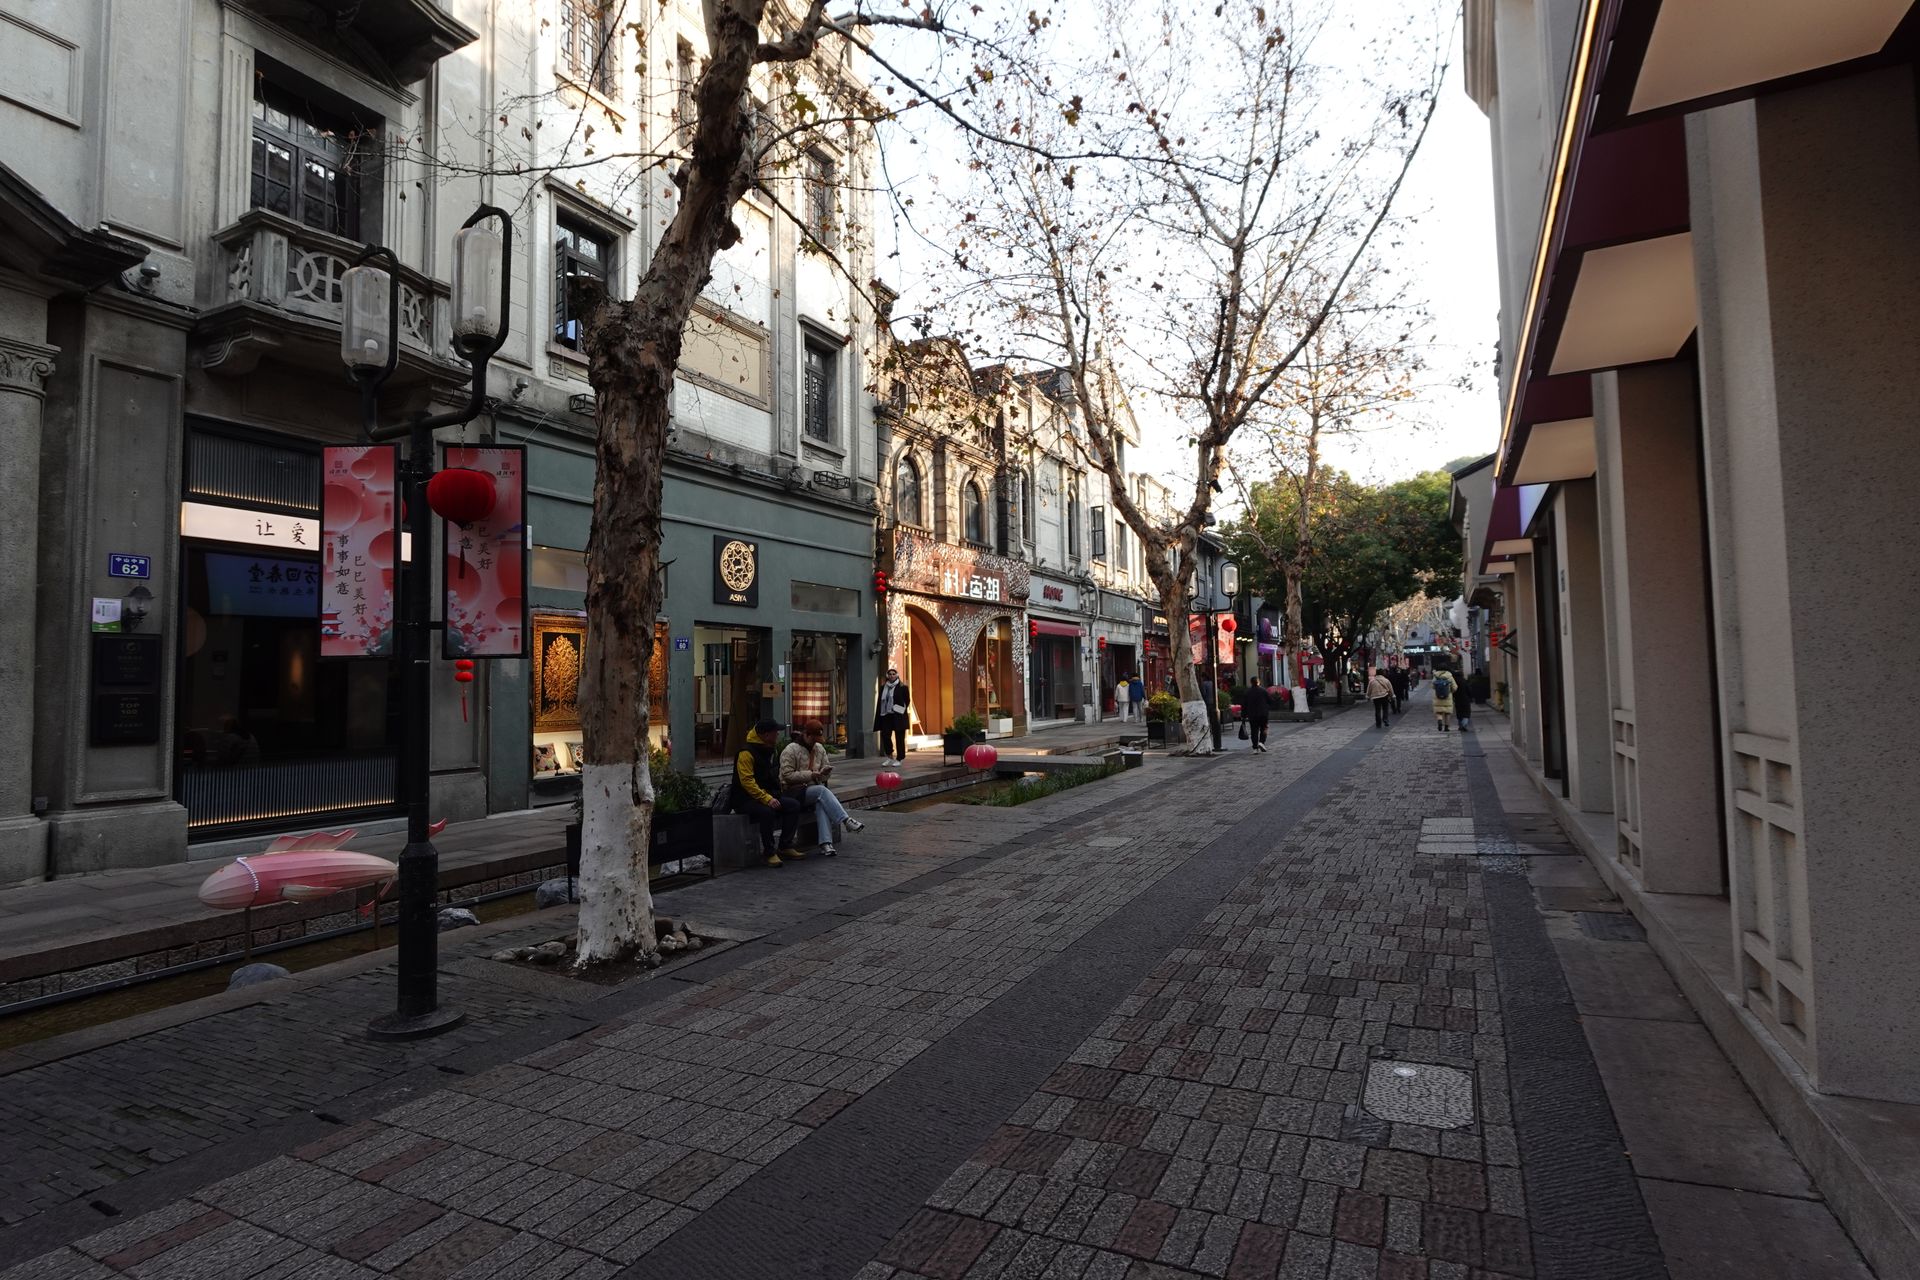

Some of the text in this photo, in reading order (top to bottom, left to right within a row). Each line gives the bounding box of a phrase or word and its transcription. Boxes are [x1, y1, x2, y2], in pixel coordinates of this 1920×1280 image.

[256, 519, 306, 546] 让爱
[122, 564, 139, 575] 62
[335, 534, 350, 596] 事事如意
[352, 555, 367, 616] 巳巳美好
[729, 593, 748, 603] ASIYA
